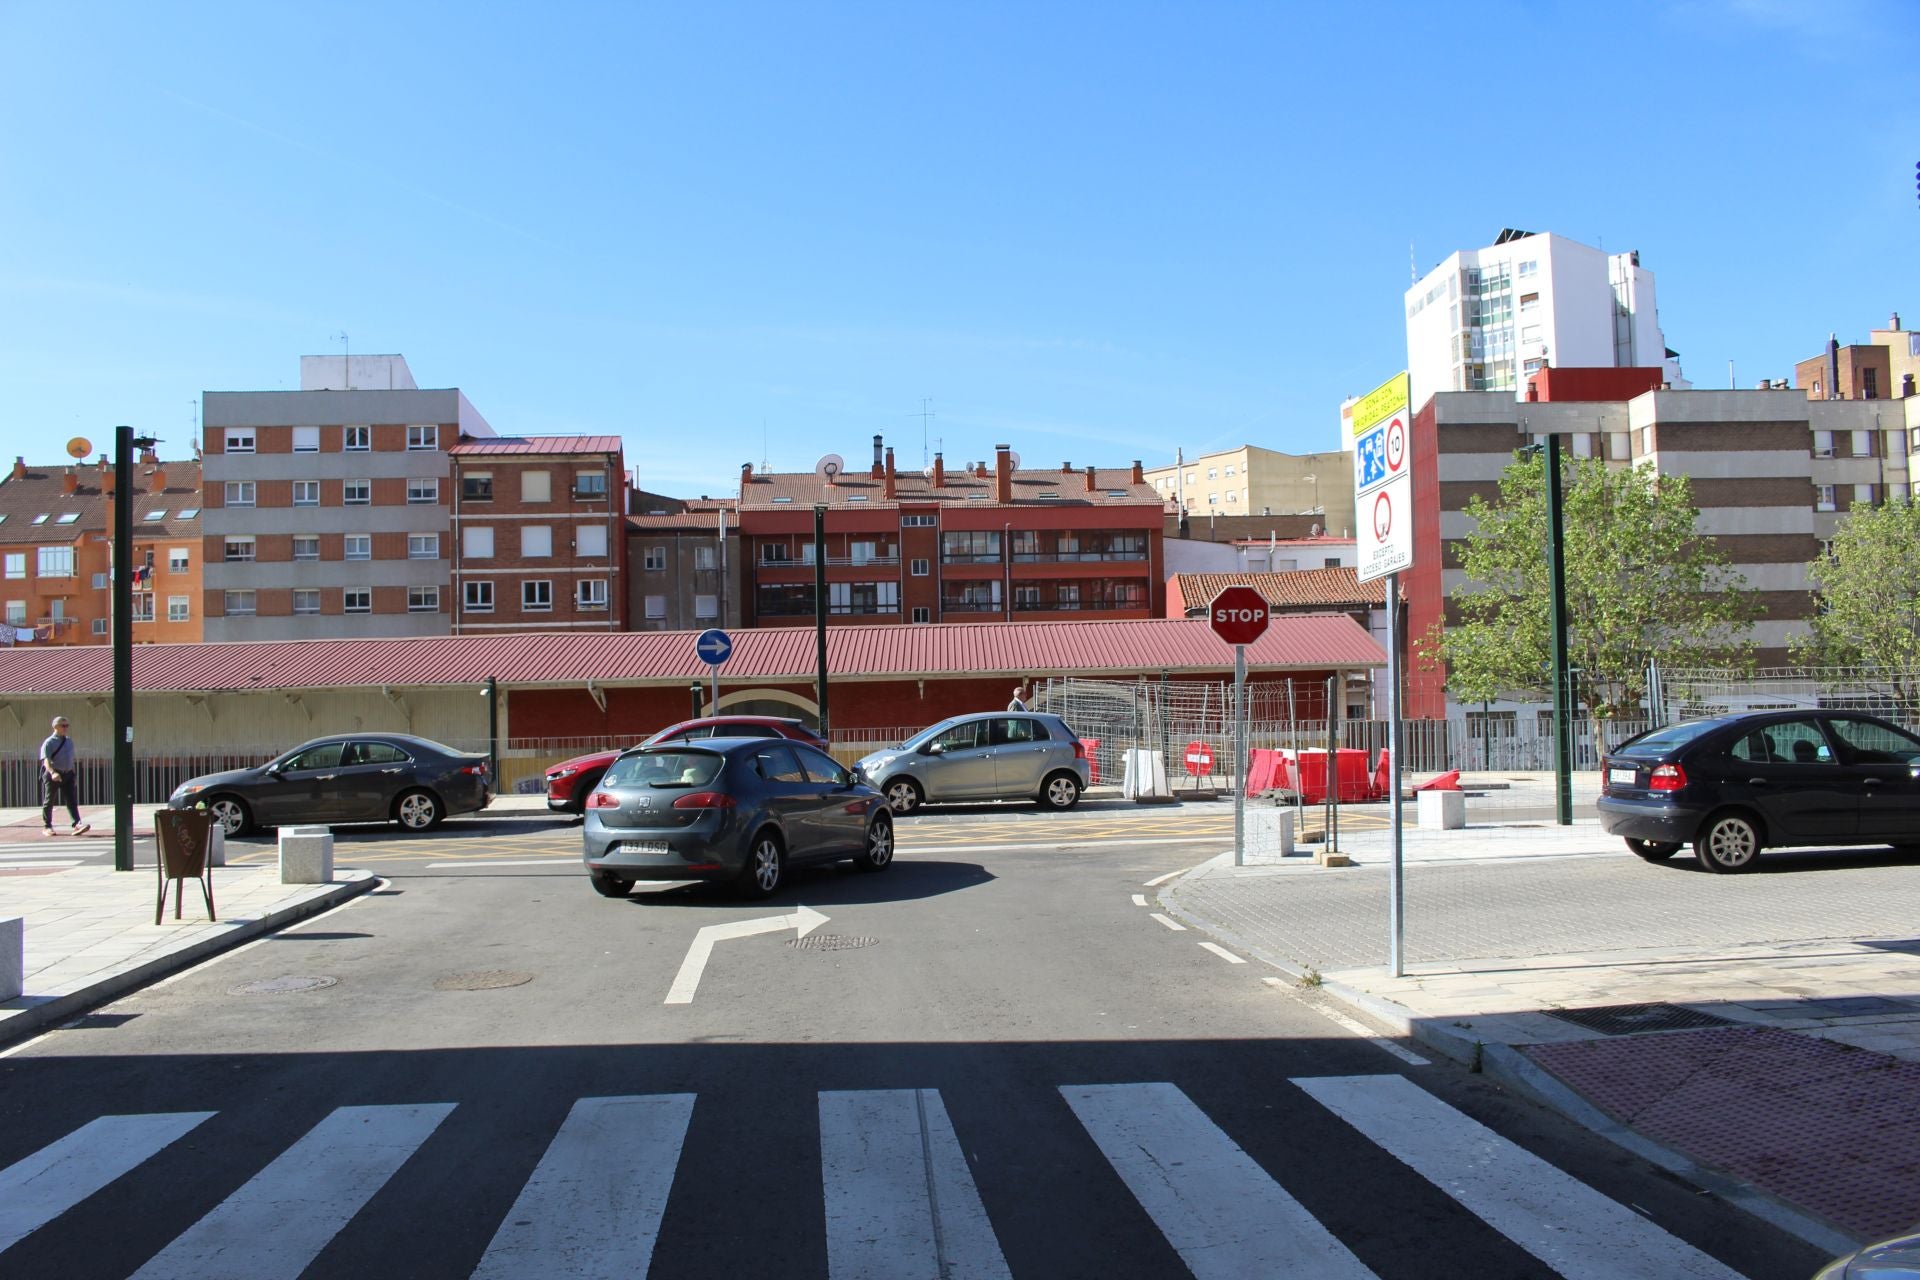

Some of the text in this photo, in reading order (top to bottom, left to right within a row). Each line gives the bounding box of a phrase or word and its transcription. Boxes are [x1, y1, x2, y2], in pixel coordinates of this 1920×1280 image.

[1365, 388, 1392, 410] ZONA CON
[1353, 392, 1407, 429] PRIORIDAD PEATONAL
[1391, 435, 1400, 454] 10
[1373, 544, 1394, 560] EXCEPTO
[1363, 552, 1404, 575] ACCESO GARAJES
[1216, 608, 1265, 623] STOP
[647, 840, 667, 853] DSG
